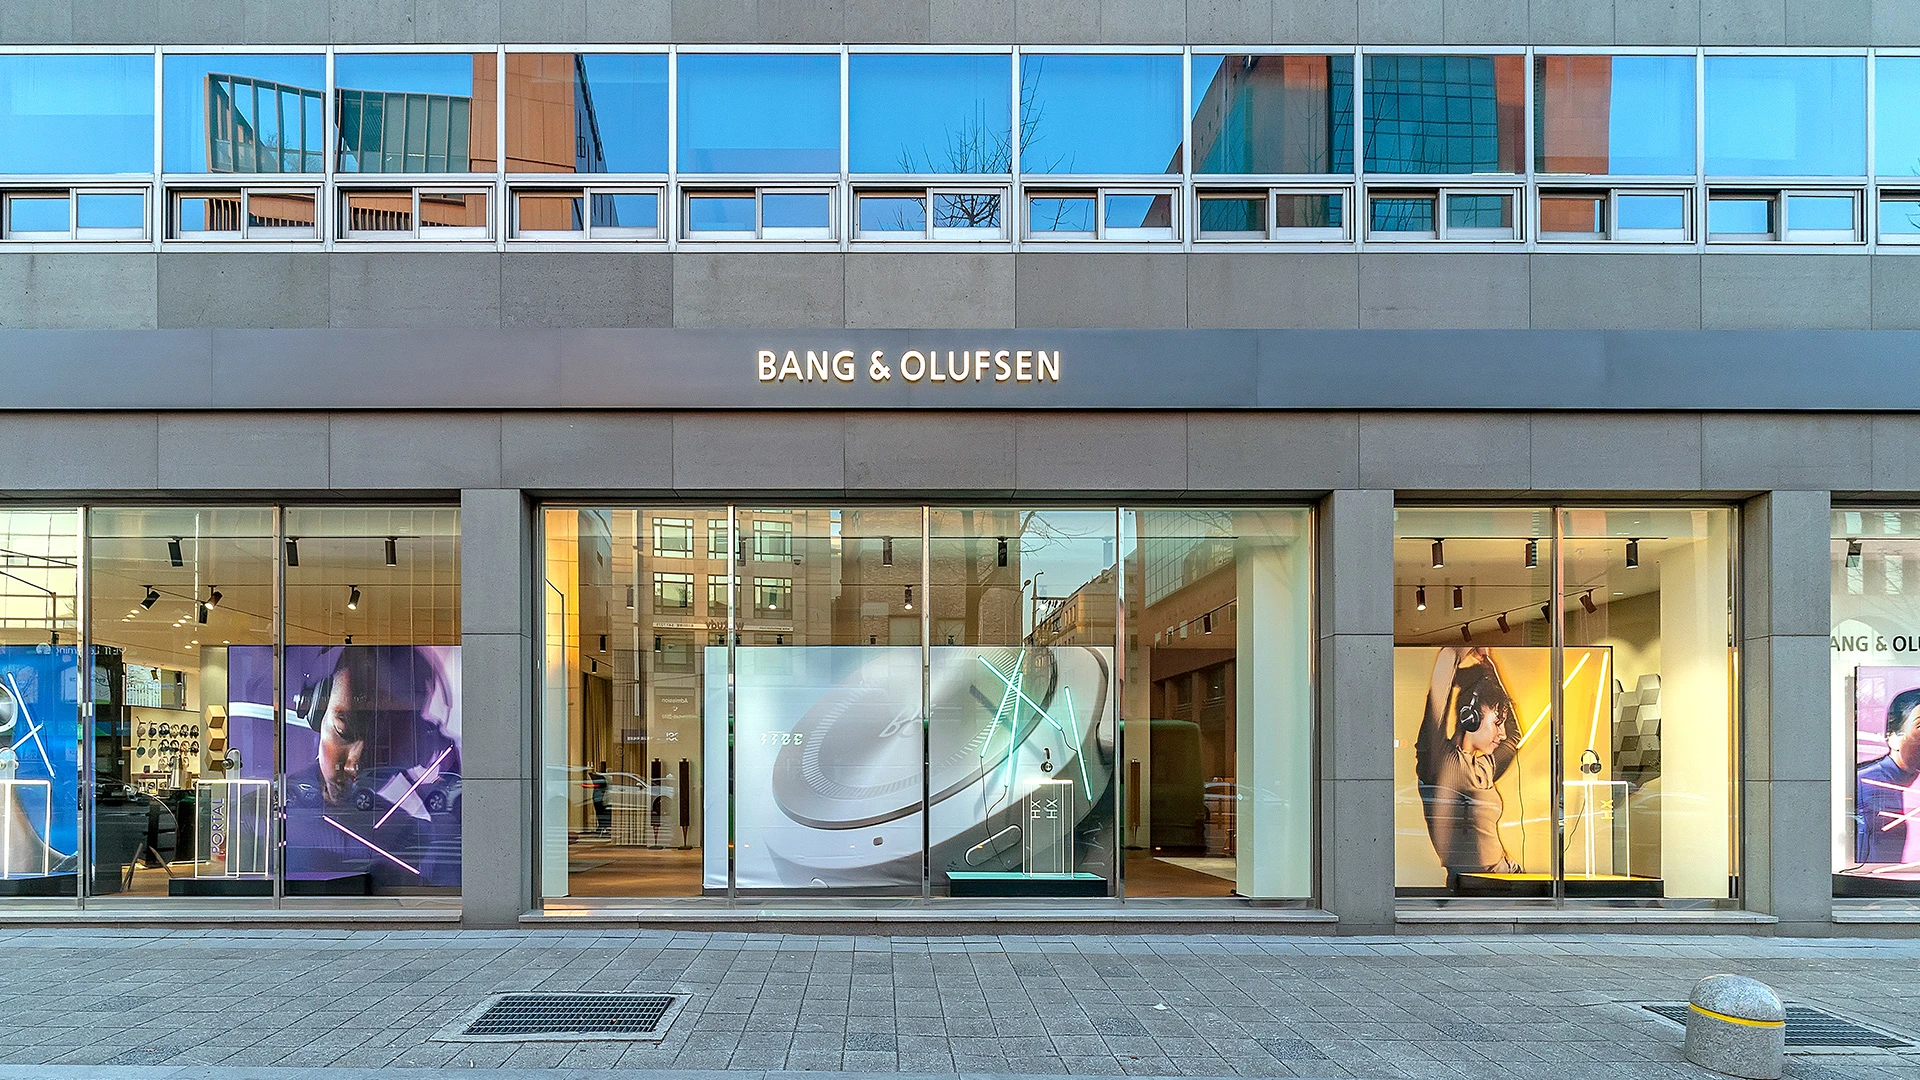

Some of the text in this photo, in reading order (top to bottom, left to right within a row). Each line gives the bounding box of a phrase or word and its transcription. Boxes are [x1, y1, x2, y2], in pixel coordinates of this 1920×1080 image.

[757, 350, 1061, 382] BANG & OLUFSEN
[1875, 636, 1888, 652] &
[1892, 635, 1920, 652] OL
[1046, 798, 1058, 819] HX
[1600, 799, 1614, 820] HX
[211, 798, 225, 854] PORTAL
